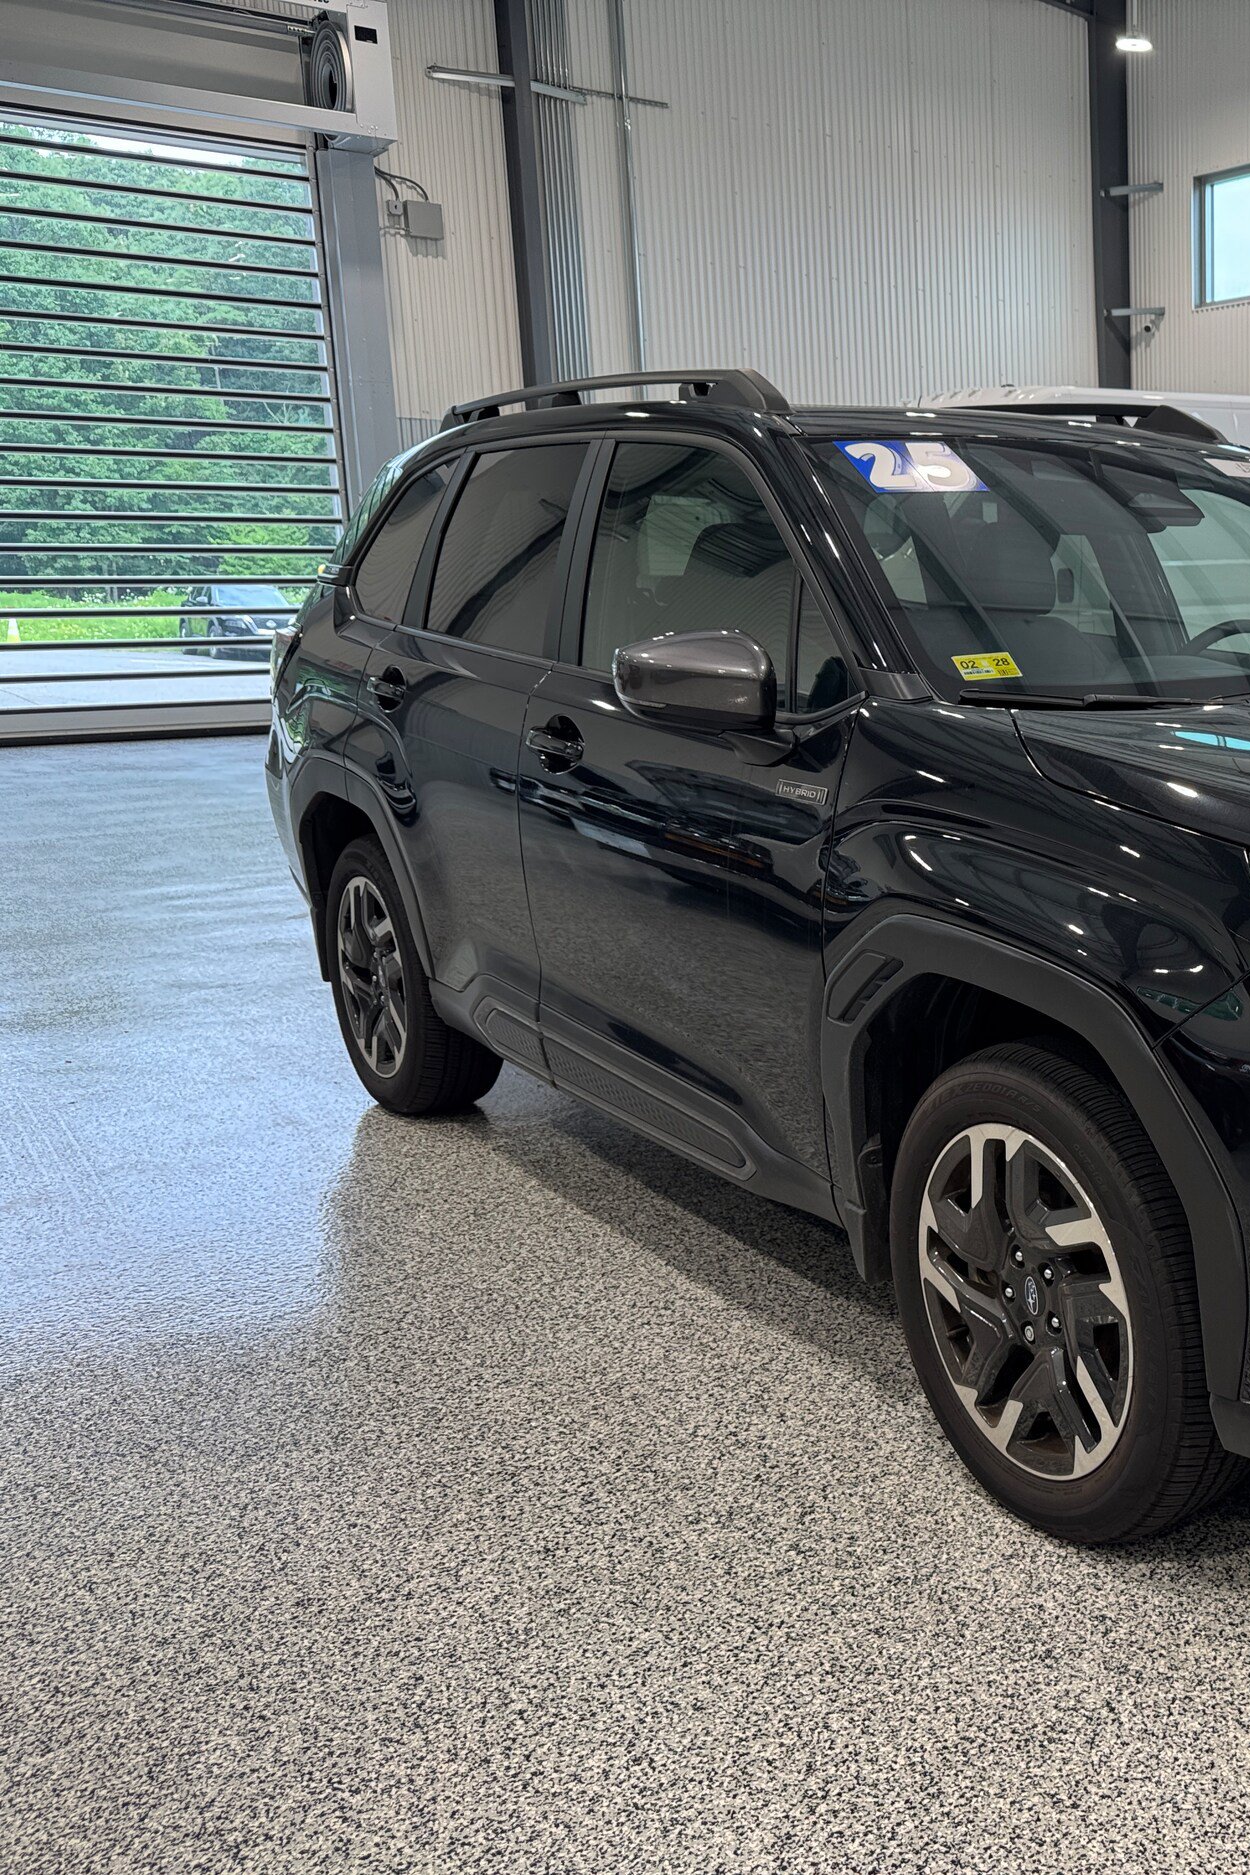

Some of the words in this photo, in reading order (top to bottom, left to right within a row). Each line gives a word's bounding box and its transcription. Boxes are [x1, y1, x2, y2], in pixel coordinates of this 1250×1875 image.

[844, 442, 974, 489] 25
[960, 660, 978, 669] 02
[992, 658, 1010, 667] 28
[783, 785, 817, 798] HYBRID
